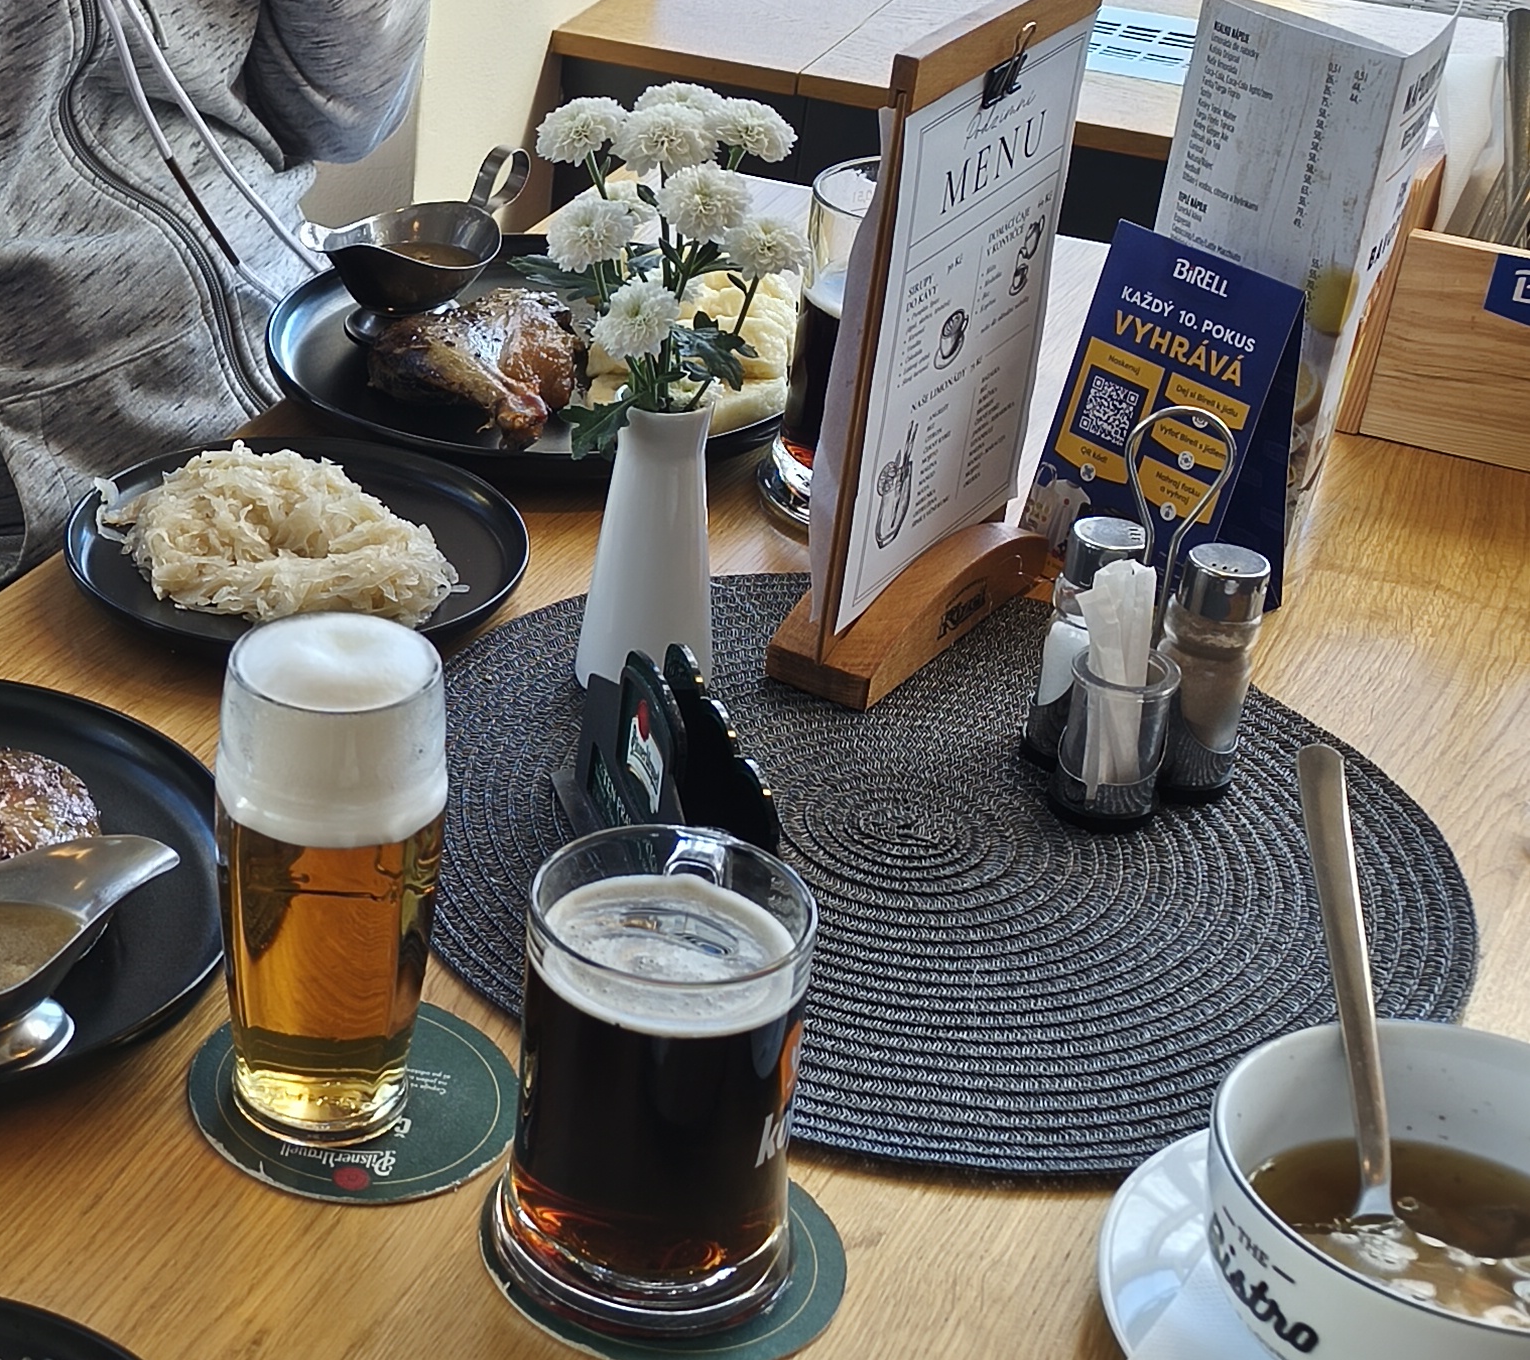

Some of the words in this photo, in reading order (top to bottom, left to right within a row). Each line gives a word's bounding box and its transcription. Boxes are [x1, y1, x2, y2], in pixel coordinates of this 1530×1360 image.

[940, 109, 1047, 215] MENU
[1121, 285, 1175, 317] KAŽDÝ
[1178, 310, 1198, 330] 10.
[1201, 319, 1256, 353] POKUS
[1108, 354, 1141, 376] Naskenuj
[1115, 309, 1245, 387] VYHRÁVÁ
[1176, 384, 1188, 398] Dej
[1189, 389, 1196, 399] si
[1197, 392, 1216, 408] Birell
[1221, 403, 1238, 418] jídlu
[1080, 446, 1092, 457] QR
[1160, 424, 1179, 440] Vyfoť
[1180, 432, 1198, 448] Birell
[1202, 443, 1226, 461] jídlem
[1155, 471, 1180, 490] Nahraj
[1181, 482, 1201, 498] fotku
[1167, 490, 1190, 506] vyhraj
[334, 1150, 397, 1176] Pilsner
[1237, 1226, 1269, 1269] THE
